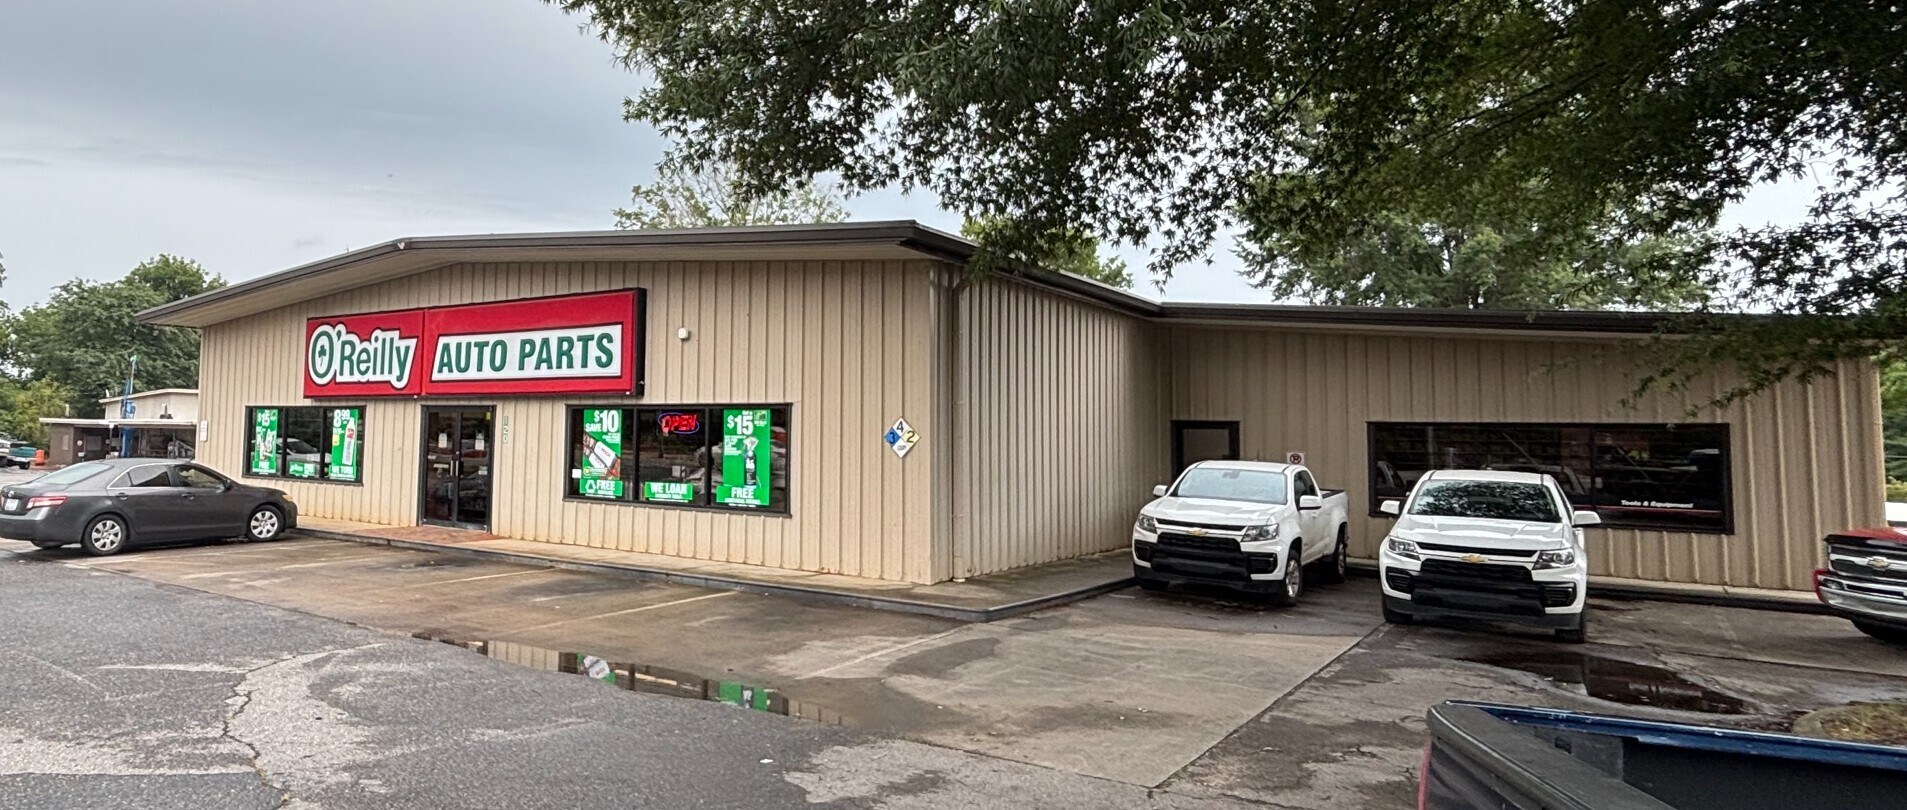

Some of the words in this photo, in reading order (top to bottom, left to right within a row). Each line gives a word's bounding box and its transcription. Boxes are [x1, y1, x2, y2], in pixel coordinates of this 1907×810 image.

[311, 329, 411, 381] O'Reilly
[437, 339, 508, 374] AUTO
[518, 332, 614, 372] PARTS
[661, 414, 697, 433] OPEN
[727, 414, 753, 435] $15
[896, 421, 904, 433] 4
[889, 431, 896, 444] 3
[906, 430, 915, 443] 2
[597, 480, 615, 490] FREE
[651, 483, 664, 493] WE
[666, 483, 688, 494] LOAN
[731, 487, 754, 499] FREE
